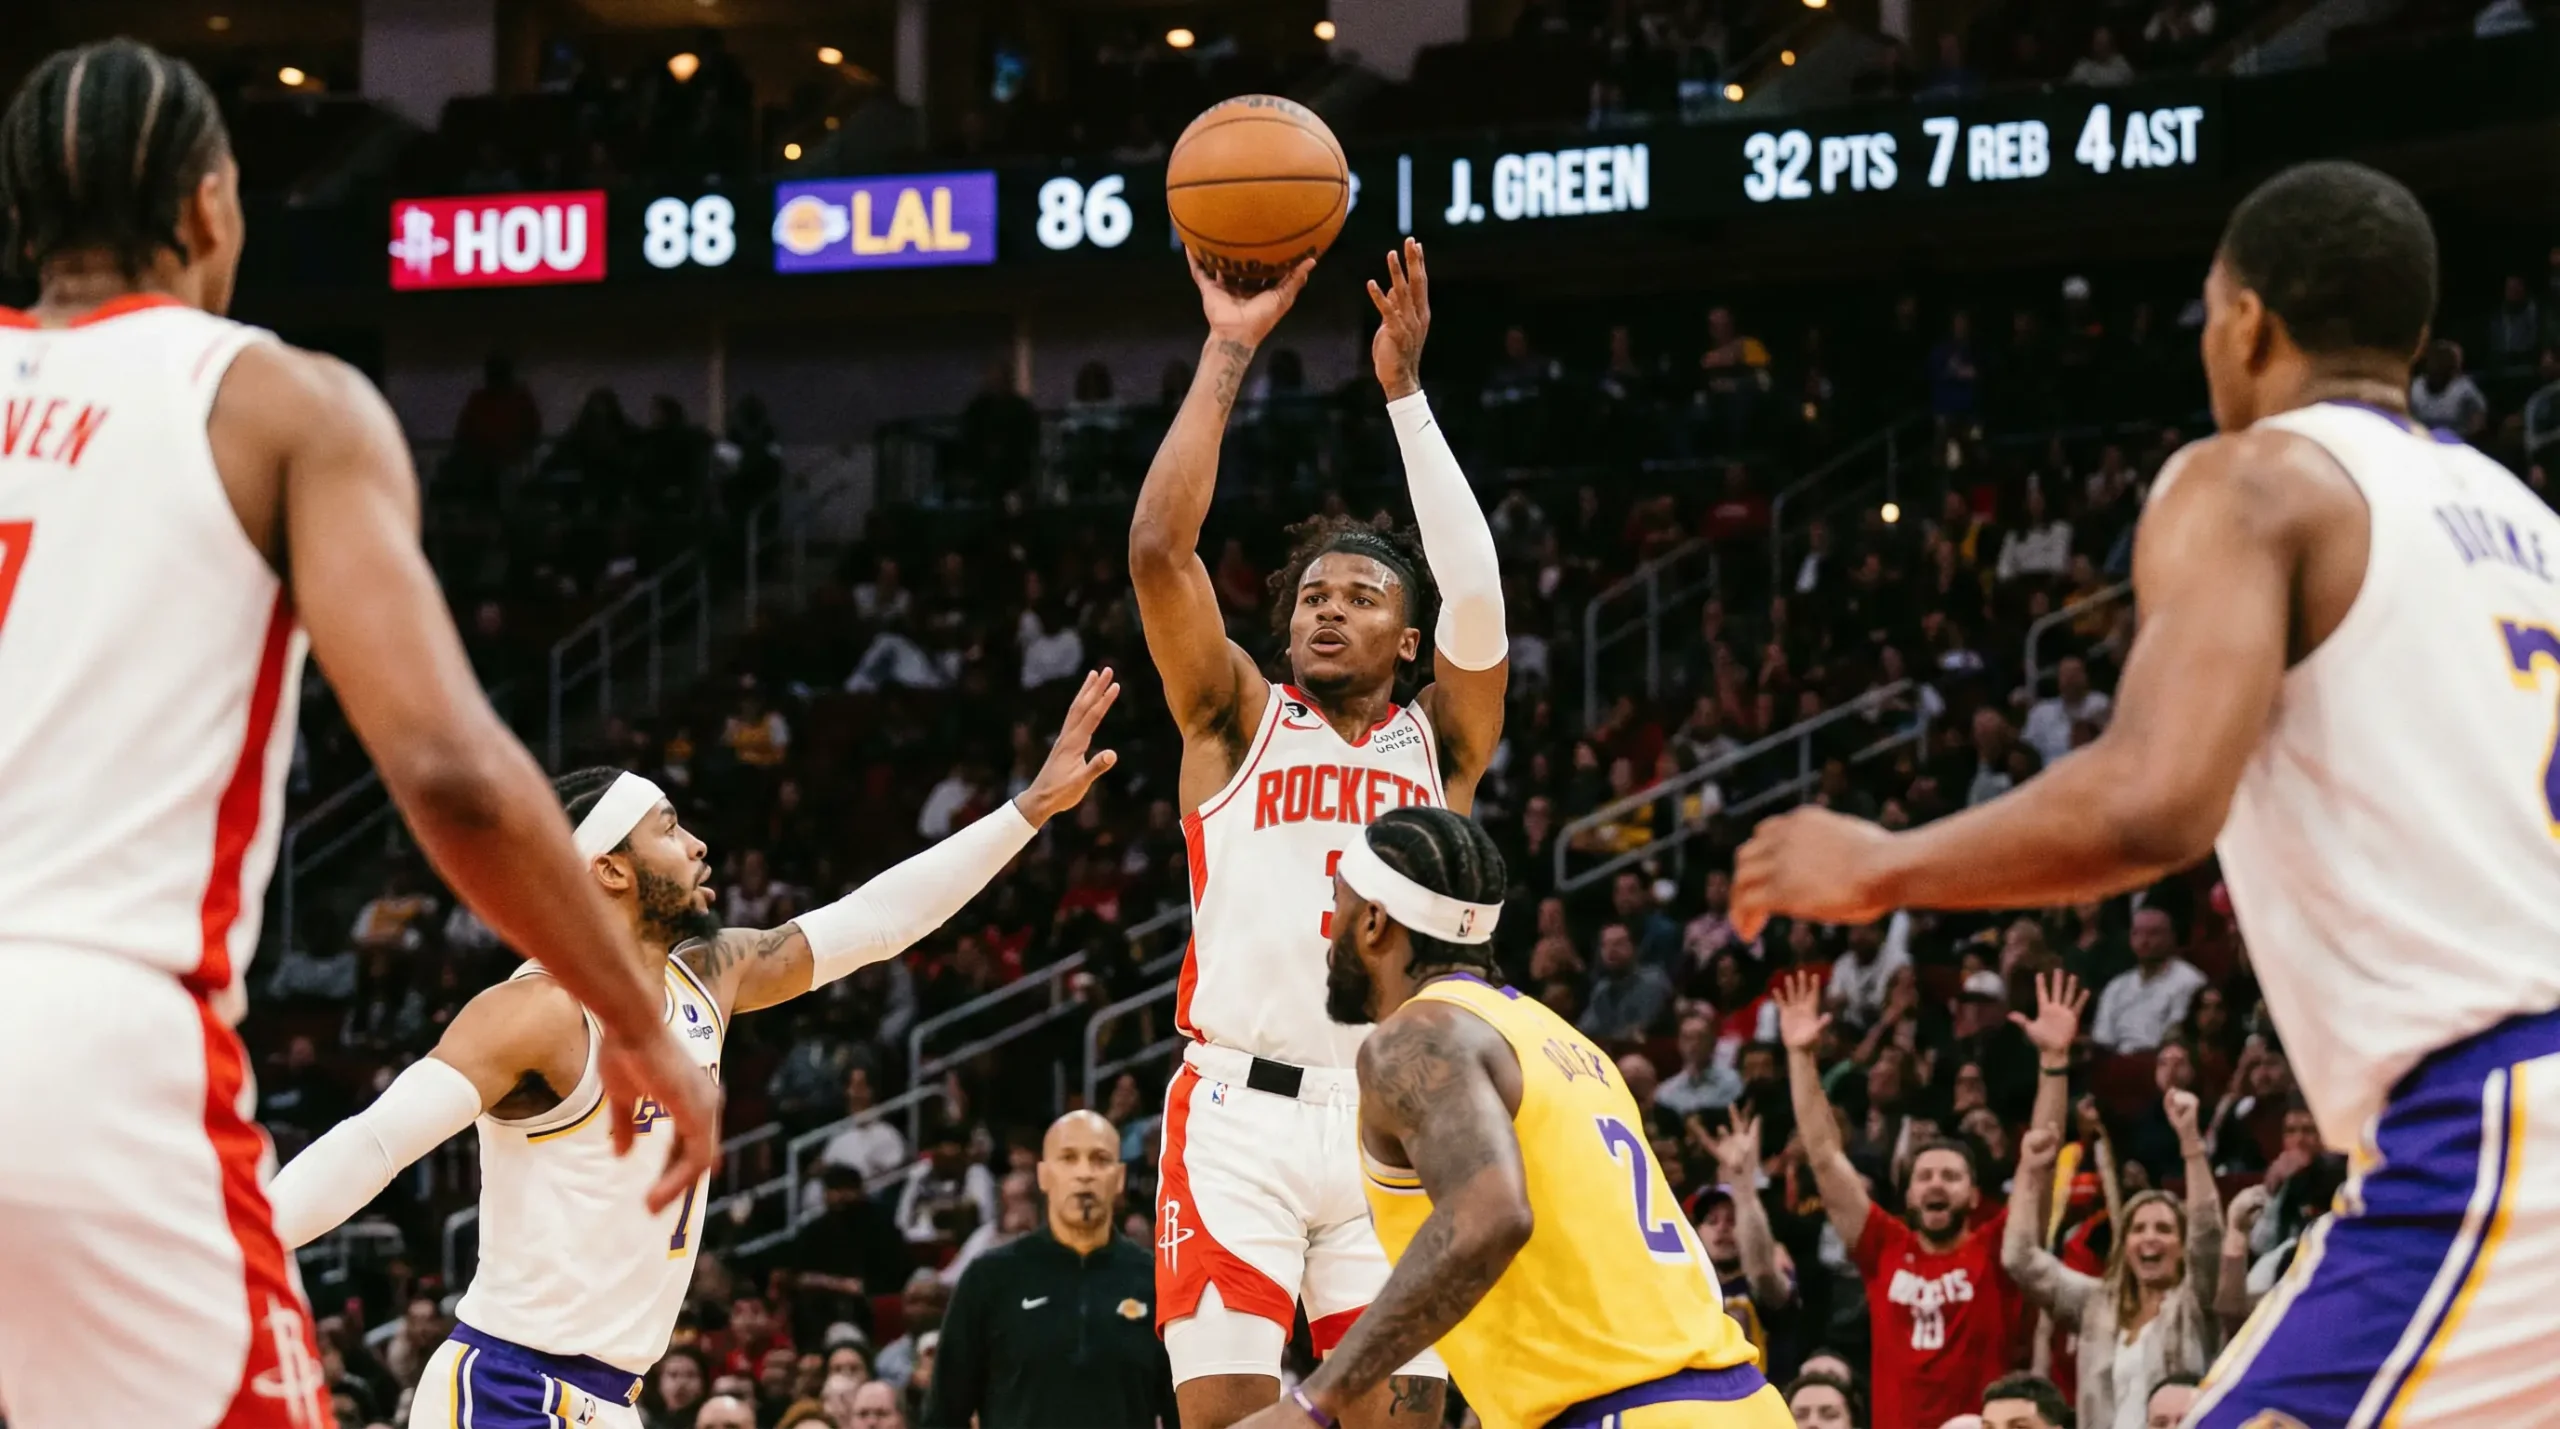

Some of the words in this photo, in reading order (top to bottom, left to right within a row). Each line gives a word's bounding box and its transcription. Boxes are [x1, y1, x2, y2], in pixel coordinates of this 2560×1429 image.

[1445, 158, 1485, 226] J.
[1492, 142, 1650, 222] GREEN
[1743, 129, 1813, 202] 32
[1819, 132, 1898, 194] PTS
[1923, 116, 1960, 188] 7
[1967, 119, 2050, 182] REB
[2075, 103, 2116, 174] 4
[2120, 106, 2205, 169] AST
[452, 206, 588, 275] HOU
[643, 195, 736, 270] 88
[852, 188, 971, 256] LAL
[1036, 173, 1133, 251] 86
[1595, 1114, 1693, 1265] 2
